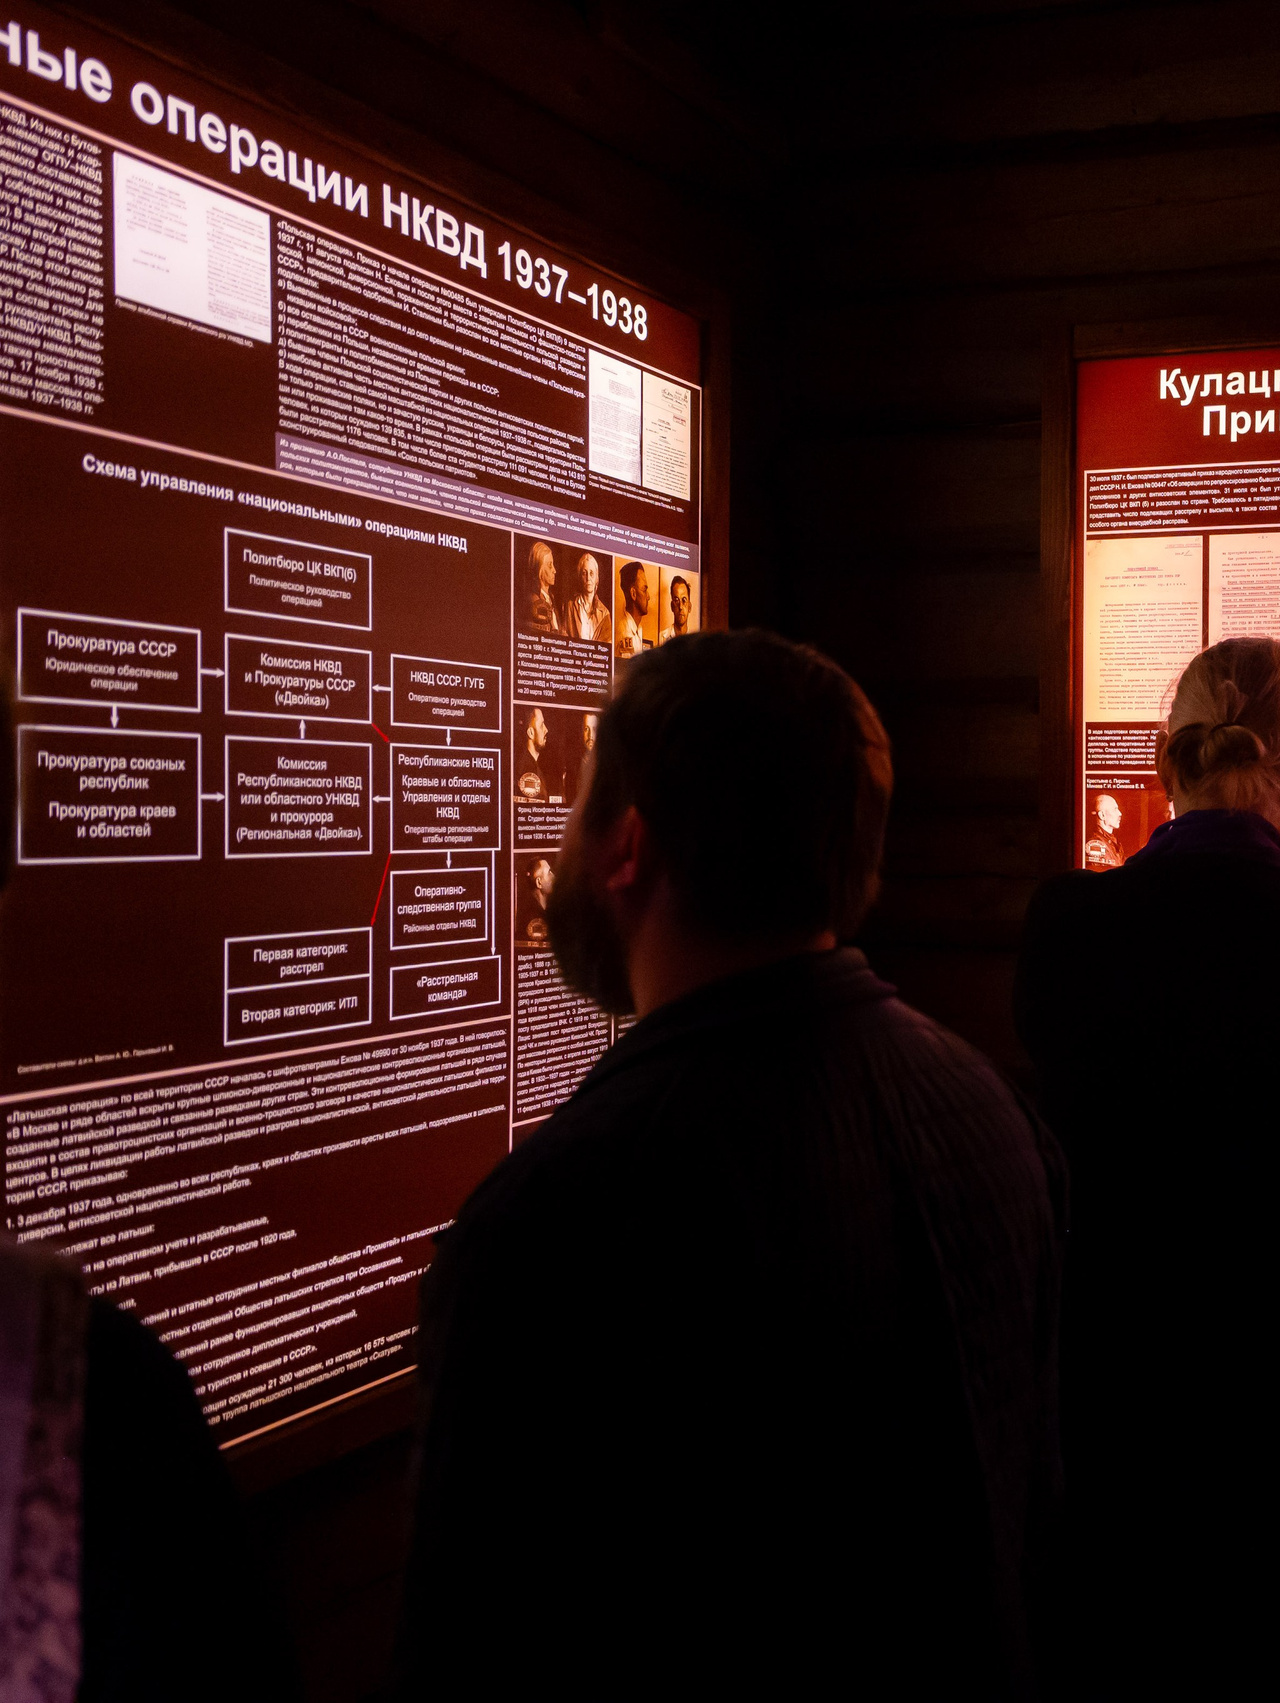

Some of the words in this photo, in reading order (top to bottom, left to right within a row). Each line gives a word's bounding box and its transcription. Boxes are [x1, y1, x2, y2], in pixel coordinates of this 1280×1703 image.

[130, 82, 368, 217] операции
[383, 183, 486, 278] НКВД
[498, 241, 647, 340] 1937–1938
[82, 454, 136, 480] Схема
[140, 470, 233, 501] управления
[237, 492, 362, 527] «национальными»
[365, 519, 435, 544] операциями
[438, 532, 467, 553] НКВД
[243, 548, 304, 572] Политбюро
[306, 560, 321, 576] ЦК
[324, 563, 356, 583] ВКП(б)
[249, 574, 304, 592] Политическое
[306, 585, 351, 599] руководство
[281, 594, 322, 607] операцией
[47, 629, 135, 655] Прокуратура
[138, 640, 176, 657] СССР
[45, 657, 115, 675] Юридическое
[117, 664, 178, 680] обеспечение
[260, 653, 311, 670] Комиссия
[314, 659, 342, 675] НКВД
[90, 678, 138, 691] операции
[255, 670, 324, 690] Прокуратуры
[326, 677, 356, 691] СССР
[410, 671, 434, 686] НКВД
[436, 673, 462, 686] СССР.
[464, 677, 484, 689] ГУГБ
[275, 690, 329, 709] («Двойка»)
[408, 692, 449, 704] Оперативное
[450, 698, 486, 707] руководство
[432, 707, 464, 716] операцией
[38, 751, 126, 772] Прокуратура
[130, 758, 185, 770] союзных
[277, 756, 326, 770] Комиссия
[398, 753, 470, 768] Республиканские
[472, 757, 494, 770] НКВД
[80, 774, 148, 792] республик
[238, 773, 332, 789] Республиканского
[335, 776, 362, 790] НКВД
[402, 775, 439, 788] Краевые
[448, 776, 490, 788] областные
[240, 794, 261, 804] или
[264, 791, 322, 805] областного
[325, 793, 359, 807] УНКВД
[402, 791, 452, 804] Управления
[461, 794, 490, 804] отделы
[49, 801, 136, 821] Прокуратура
[140, 806, 176, 820] краев
[280, 812, 333, 824] прокурора
[436, 807, 459, 819] НКВД
[77, 826, 86, 837] и
[89, 822, 150, 837] областей
[236, 827, 312, 842] (Региональная
[314, 826, 362, 840] «Двойка»).
[404, 825, 446, 834] Оперативные
[447, 826, 488, 834] региональные
[422, 834, 443, 843] штабы
[444, 835, 472, 843] операции
[414, 885, 466, 898] Оперативно-
[397, 902, 454, 915] следственная
[456, 900, 481, 912] группа
[403, 924, 435, 932] Районные
[436, 922, 458, 930] отделы
[459, 918, 476, 928] НКВД
[254, 948, 294, 963] Первая
[296, 944, 347, 957] категория:
[280, 962, 324, 977] расстрел
[416, 972, 478, 987] «Расстрельная
[428, 989, 467, 1002] команда»
[242, 1008, 280, 1023] Вторая
[283, 1001, 336, 1017] категория:
[339, 996, 357, 1009] ИТЛ
